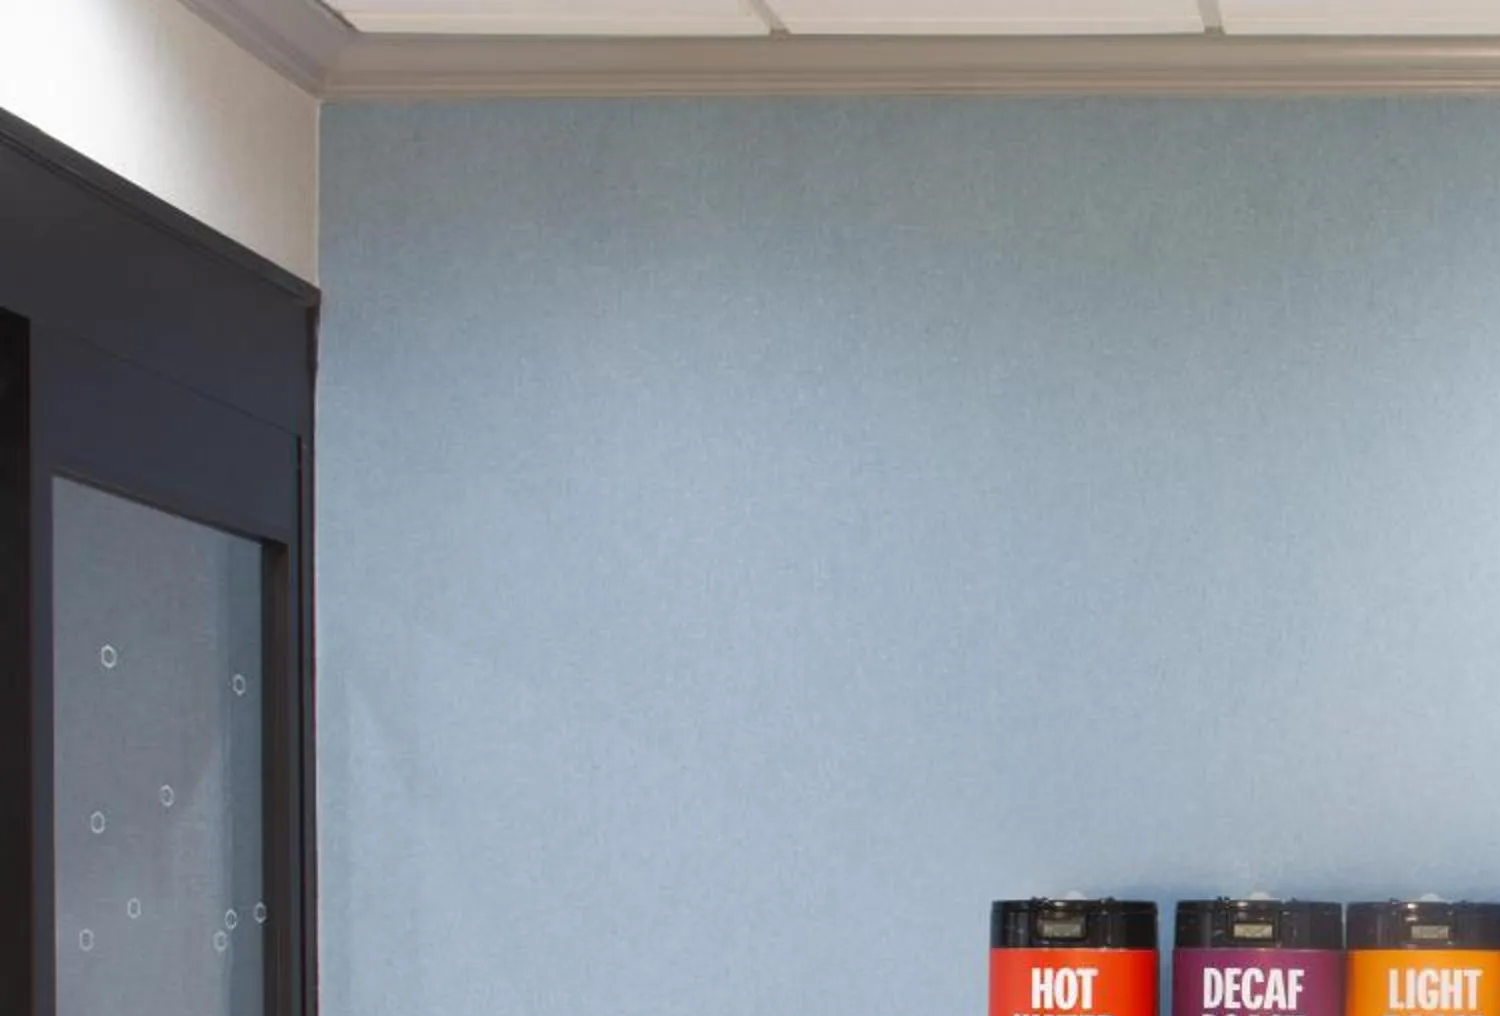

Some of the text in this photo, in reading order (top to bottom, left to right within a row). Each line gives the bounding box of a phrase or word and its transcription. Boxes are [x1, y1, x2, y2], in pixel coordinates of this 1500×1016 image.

[1031, 967, 1099, 1010] HOT
[1203, 967, 1305, 1010] DECAF
[1388, 967, 1483, 1011] LIGHT
